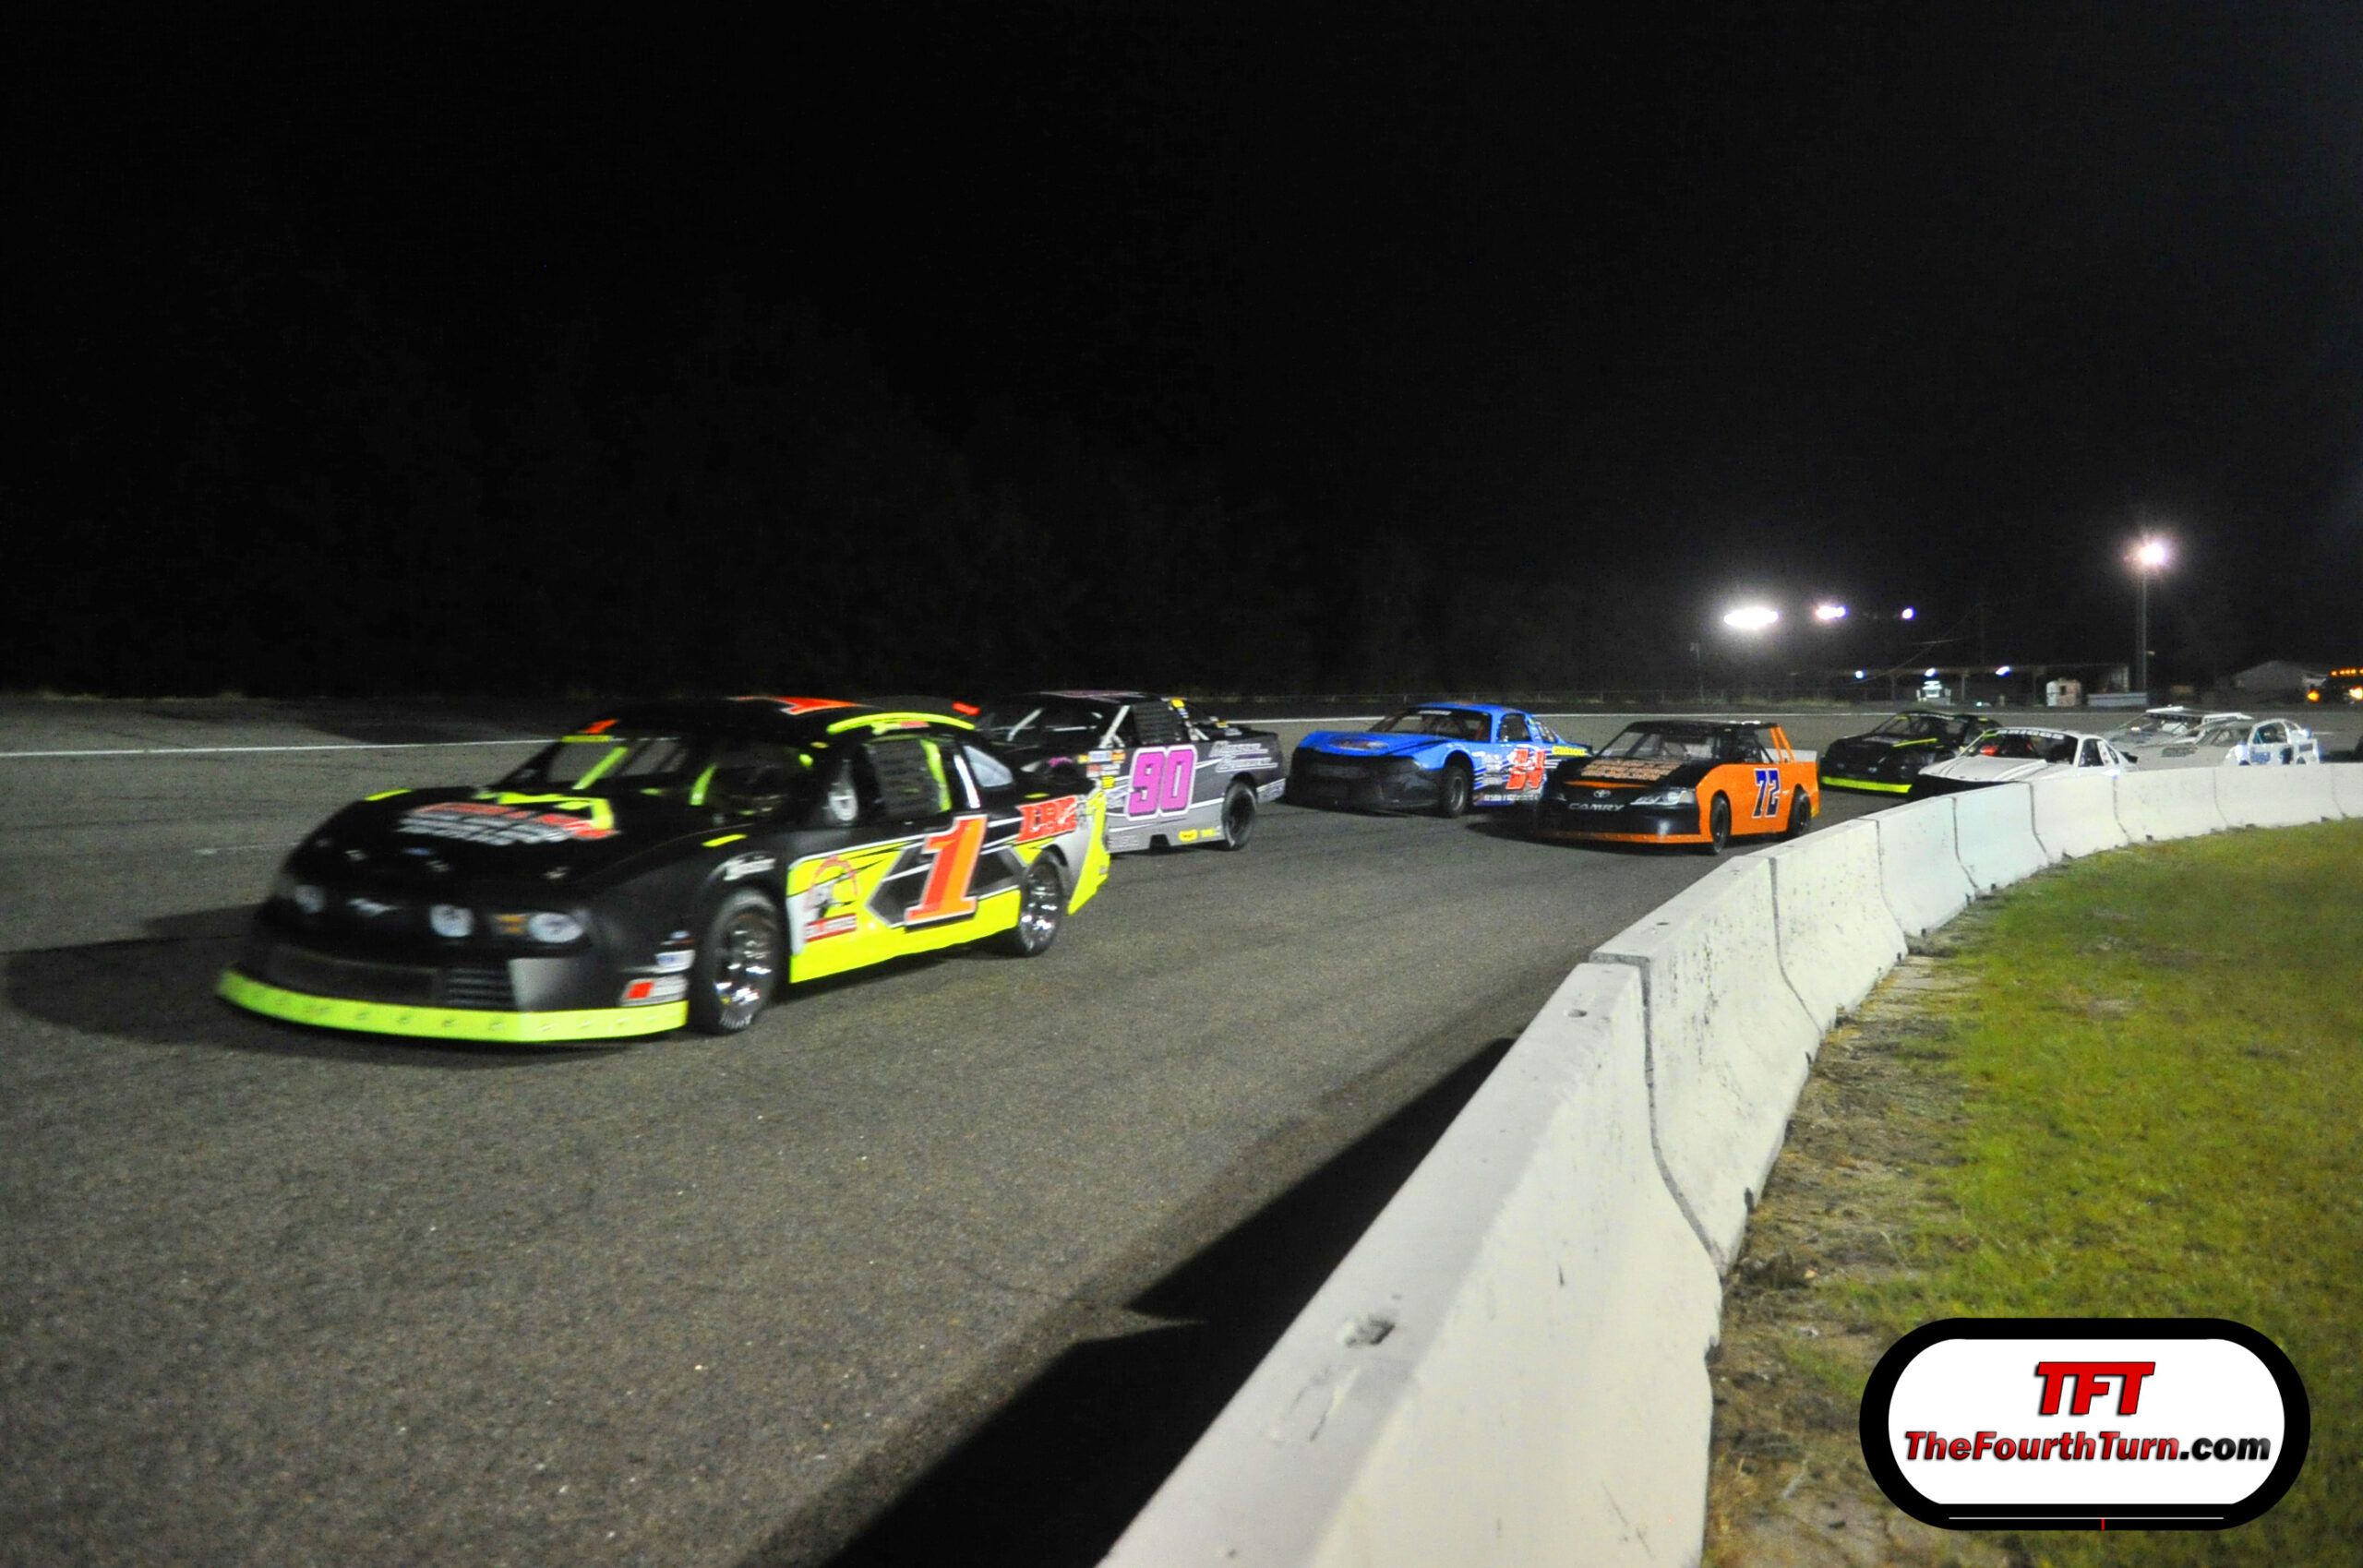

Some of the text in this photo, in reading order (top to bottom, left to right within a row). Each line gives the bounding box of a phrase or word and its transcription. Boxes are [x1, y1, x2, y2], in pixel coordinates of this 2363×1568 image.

[1125, 744, 1198, 821] 90
[1569, 802, 1625, 812] CAMRY
[1752, 768, 1781, 819] 72
[904, 813, 989, 927] 1
